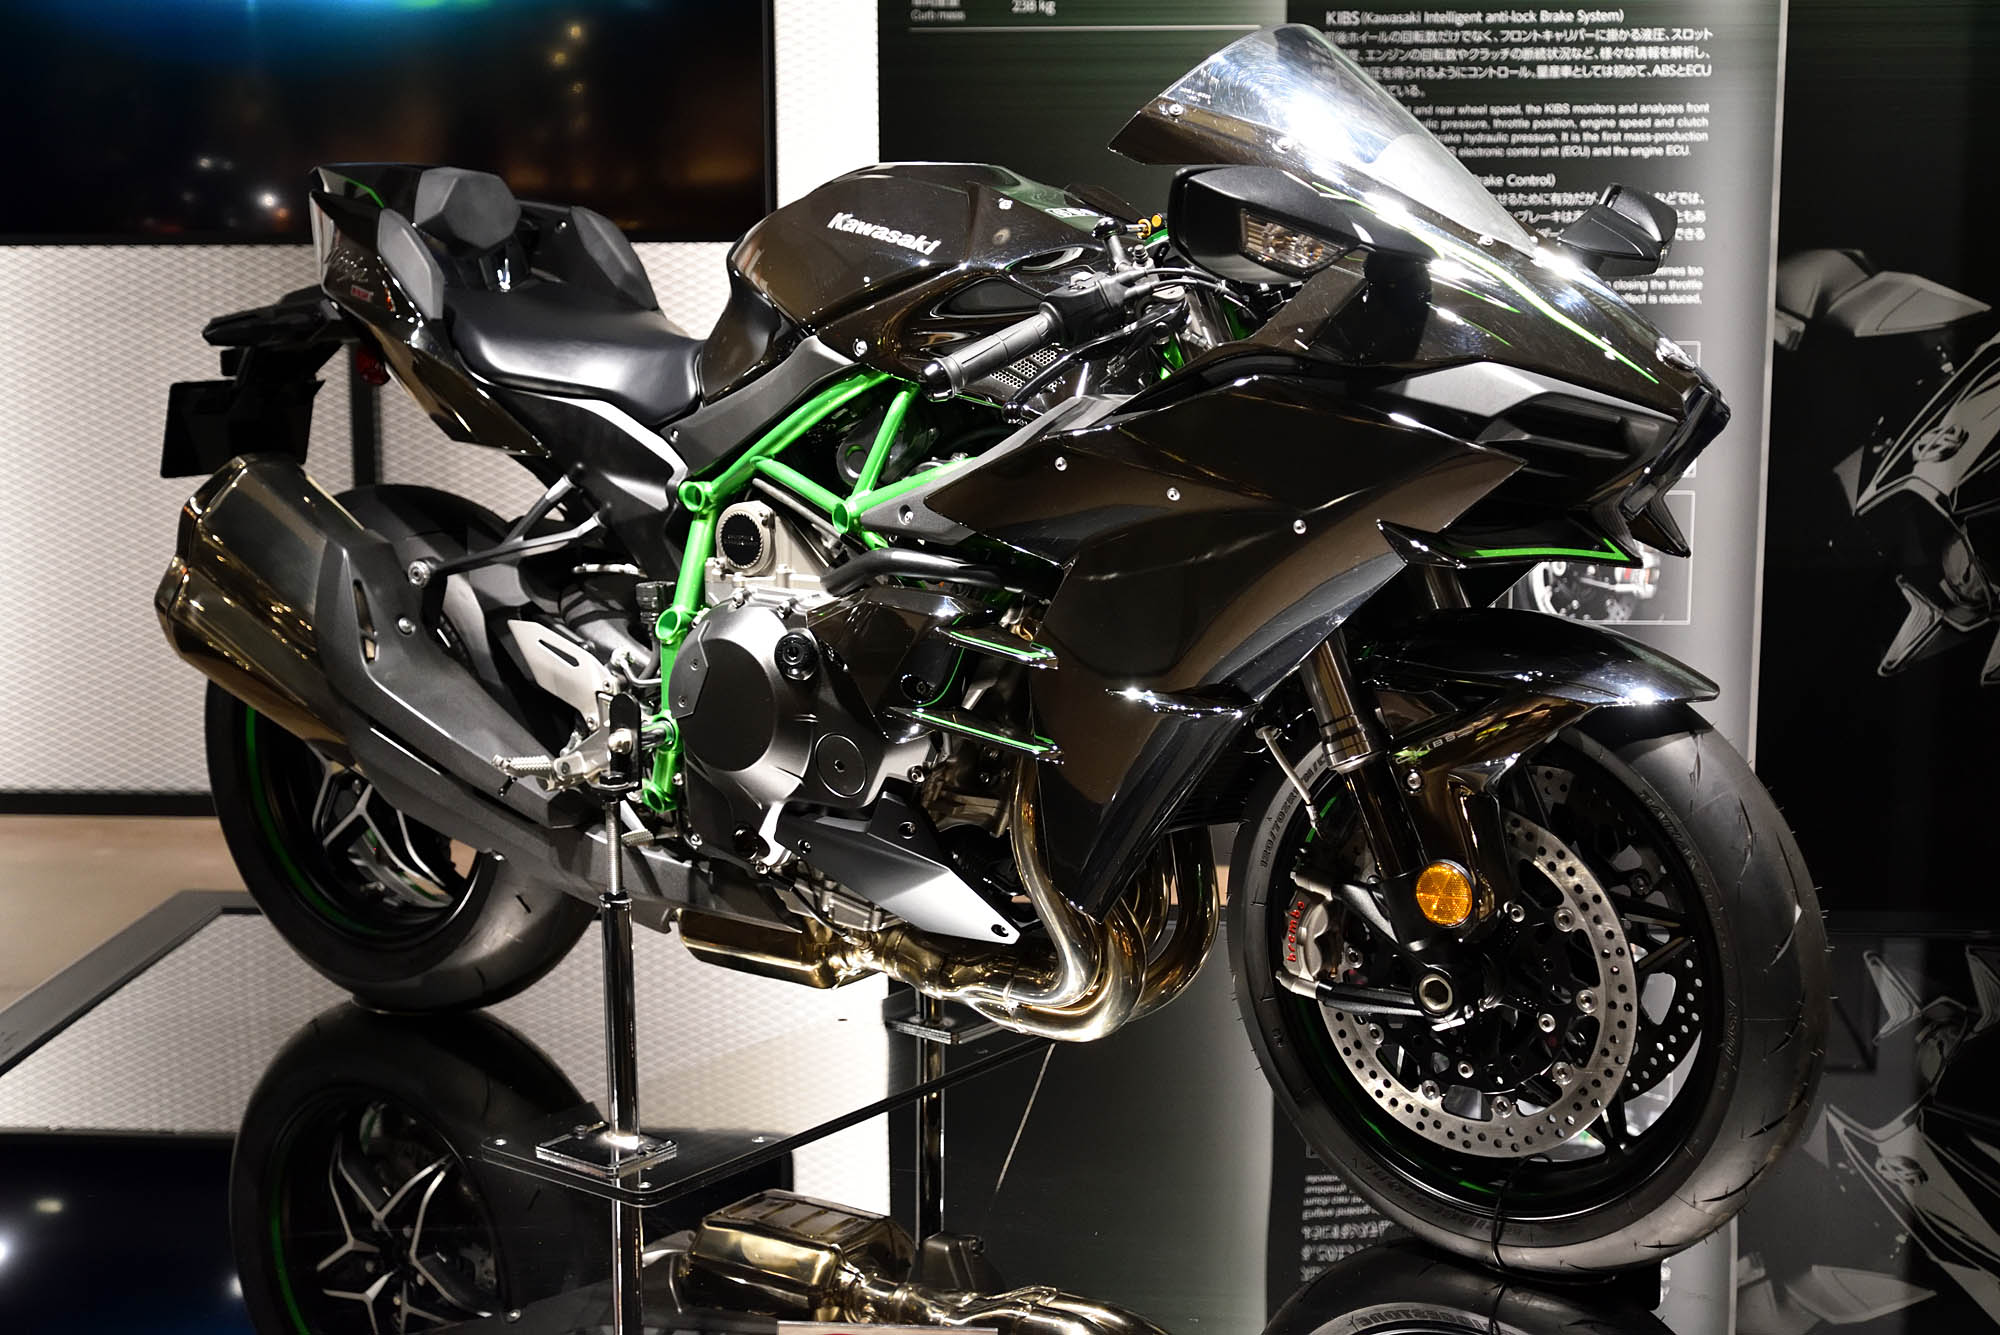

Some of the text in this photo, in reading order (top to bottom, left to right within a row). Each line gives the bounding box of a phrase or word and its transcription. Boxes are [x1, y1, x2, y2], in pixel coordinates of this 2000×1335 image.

[1038, 0, 1056, 16] kg
[1325, 11, 1360, 25] KIBS
[1423, 11, 1483, 27] Intelligent
[1485, 11, 1537, 24] anti-lock
[1539, 11, 1574, 24] Brake
[1576, 9, 1624, 25] System)
[1413, 105, 1433, 116] and
[1457, 104, 1488, 116] wheel
[1525, 103, 1542, 115] the
[1544, 103, 1570, 115] KIBS
[1572, 103, 1617, 115] monitors
[1617, 103, 1638, 114] and
[1639, 103, 1685, 116] analyzes
[1686, 102, 1710, 114] front
[1492, 118, 1531, 129] throttle
[1579, 118, 1617, 131] engine
[1618, 117, 1651, 130] speed
[1653, 117, 1675, 128] and
[1676, 116, 1709, 128] clutch
[1435, 133, 1462, 143] rake
[1463, 132, 1510, 145] hydraulic
[1560, 132, 1569, 143] It
[1570, 132, 1581, 143] is
[1582, 132, 1600, 143] the
[1601, 131, 1622, 143] first
[1623, 131, 1709, 144] mass-production
[1458, 147, 1505, 158] electronic
[1506, 147, 1540, 158] control
[1541, 146, 1560, 157] unit
[1561, 144, 1590, 159] (ECU)
[1591, 146, 1612, 157] and
[1613, 146, 1630, 157] the
[1630, 146, 1664, 159] engine
[1474, 173, 1556, 188] rake Control)
[827, 211, 942, 255] Kawasaki
[1613, 279, 1648, 292] closing
[1650, 279, 1667, 290] the
[1668, 279, 1703, 290] throttle
[1286, 901, 1305, 962] brembo
